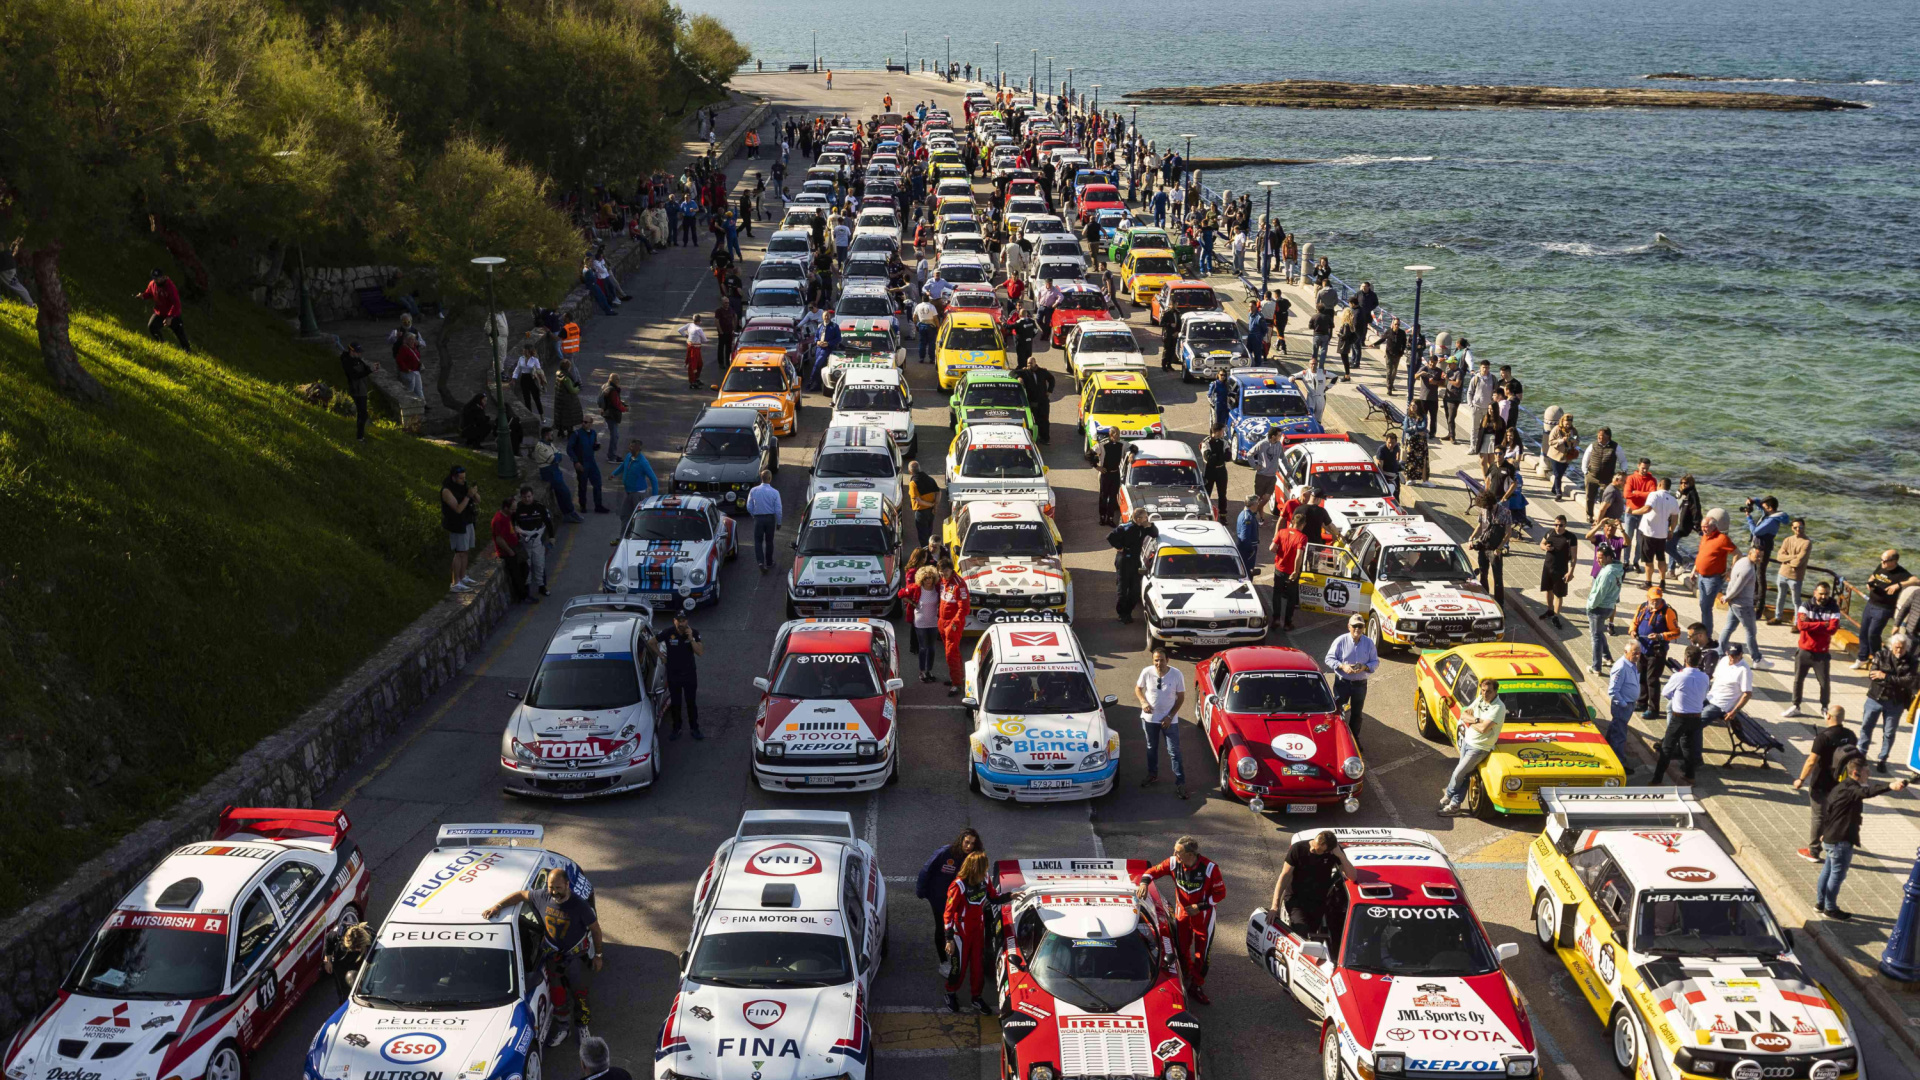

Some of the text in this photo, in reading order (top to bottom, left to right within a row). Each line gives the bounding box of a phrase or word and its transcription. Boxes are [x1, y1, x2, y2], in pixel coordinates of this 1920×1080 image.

[815, 559, 872, 570] totip
[1326, 588, 1347, 604] 105
[994, 612, 1064, 623] CITROËN
[810, 655, 861, 664] TOYOTA
[798, 732, 862, 741] TOYOTA
[1025, 728, 1088, 740] Costa
[539, 742, 605, 758] TOTAL
[789, 742, 853, 751] REPSOL
[1013, 740, 1090, 753] Blanca
[1285, 742, 1304, 751] 30
[632, 755, 647, 763] TOTAL
[1030, 752, 1068, 761] TOTAL
[1522, 757, 1601, 768] LaRoca
[557, 781, 586, 791] 206
[1033, 780, 1053, 788] 5792
[1380, 828, 1393, 838] Oy
[1648, 833, 1681, 844] HB
[758, 855, 814, 864] FINA
[1354, 854, 1431, 862] REPSOL
[458, 852, 505, 884] SPORT
[1032, 860, 1063, 870] LANCIA
[1070, 860, 1114, 870] PIRELLI
[401, 848, 484, 908] PEUGEOT
[1669, 870, 1712, 878] Audi
[1554, 868, 1577, 901] quattro
[1041, 894, 1133, 904] PIRELLI
[1646, 894, 1671, 903] HB
[1710, 894, 1756, 902] TEAM
[1387, 907, 1460, 919] TOYOTA
[131, 915, 197, 929] MITSUBISHI
[732, 916, 757, 924] FINA
[758, 915, 797, 923] MOTOR
[800, 916, 818, 924] OIL
[544, 914, 571, 940] 67
[392, 931, 500, 942] PEUGEOT
[1266, 930, 1296, 961] DIESEL
[1581, 932, 1594, 954] HB
[1571, 960, 1585, 976] BOSCH
[260, 976, 276, 1007] 70
[746, 1008, 780, 1017] FINA
[377, 1016, 470, 1026] PEUGEOT
[1004, 1020, 1038, 1028] Alitalia
[1058, 1015, 1145, 1029] PIRELLI
[1468, 1011, 1486, 1026] Oy
[82, 1026, 126, 1034] MITSUBISHI
[1166, 1020, 1200, 1029] Alitalia
[1714, 1020, 1732, 1032] HB
[1795, 1021, 1813, 1033] HB
[83, 1032, 116, 1040] MOTORS
[1418, 1028, 1507, 1042] TOYOTA
[1659, 1022, 1678, 1045] Castrol
[1344, 1029, 1359, 1053] REPSOL
[1755, 1036, 1790, 1046] Audi
[390, 1040, 437, 1055] Esso
[717, 1037, 801, 1060] FINA
[1408, 1058, 1501, 1072] REPSOL
[363, 1070, 444, 1080] ULTRON
